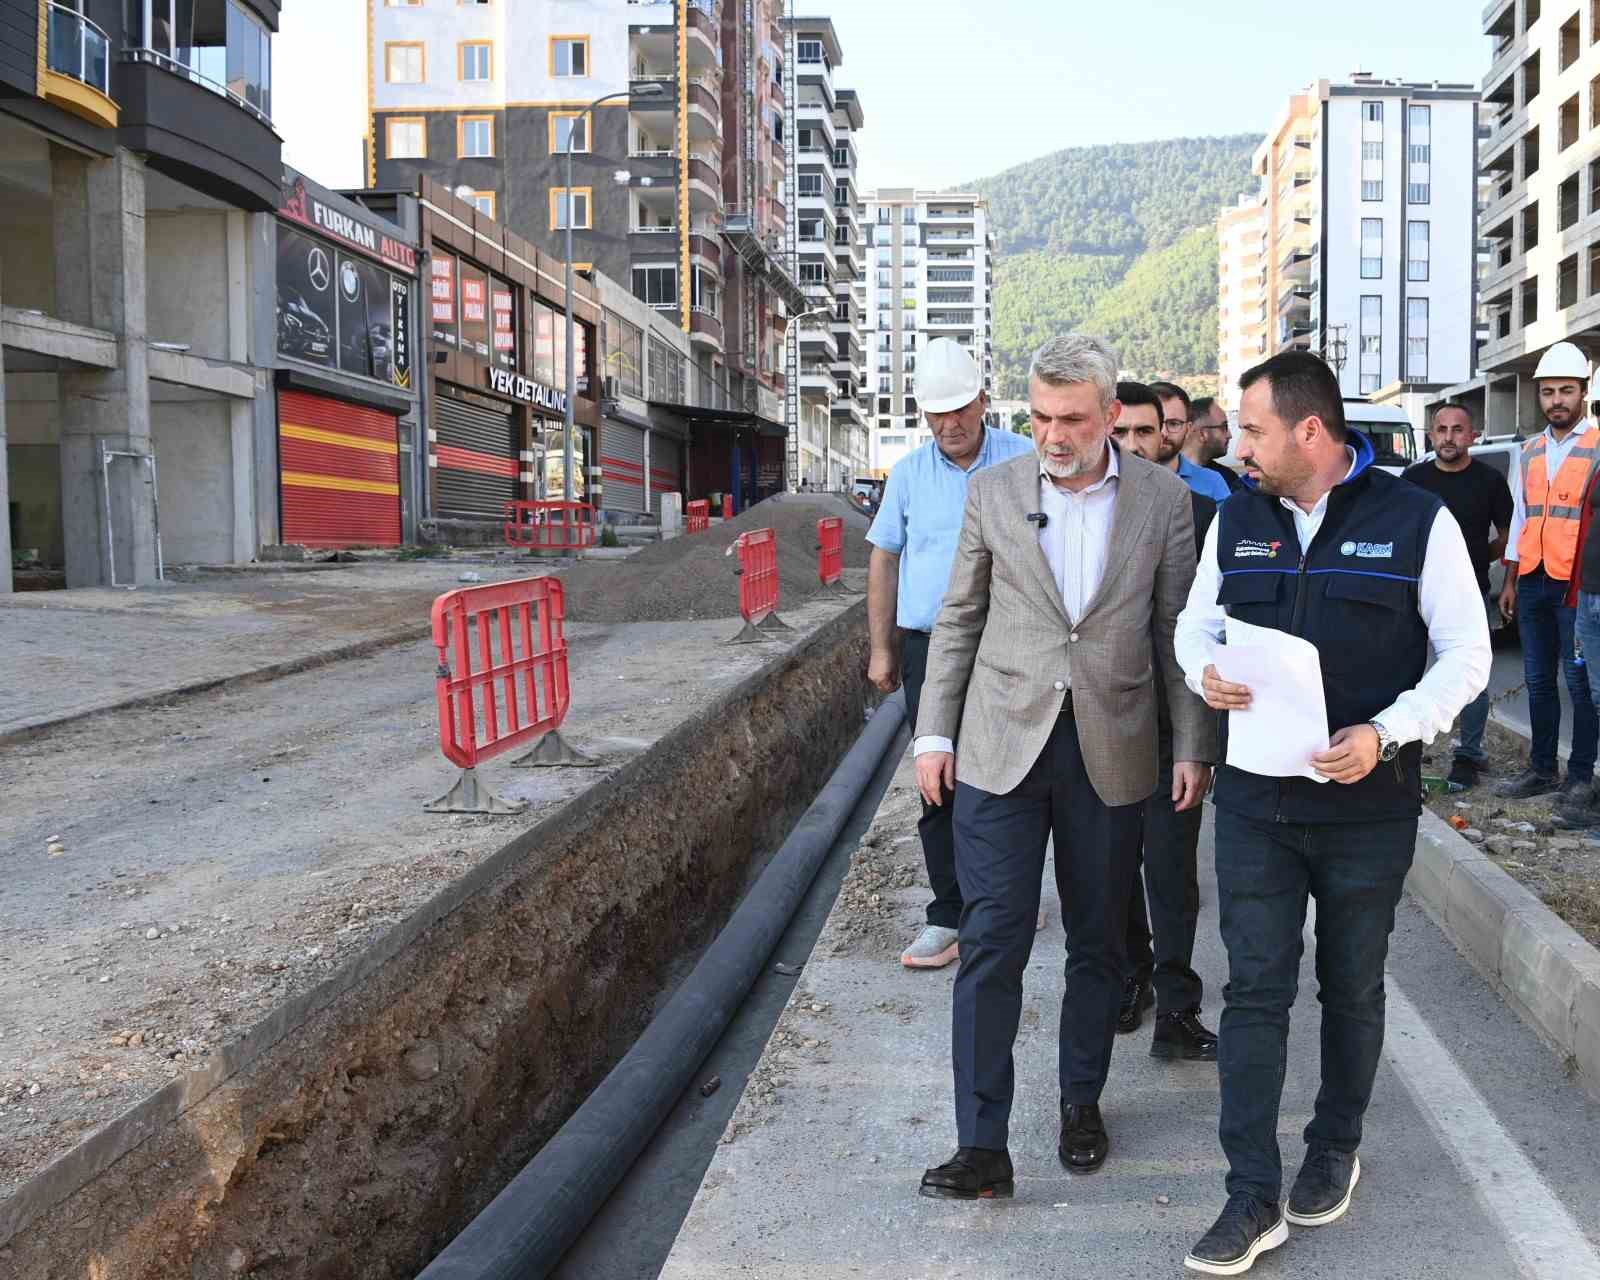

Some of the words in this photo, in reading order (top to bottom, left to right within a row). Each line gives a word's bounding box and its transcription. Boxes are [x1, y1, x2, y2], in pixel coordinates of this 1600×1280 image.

[313, 200, 376, 250] FURKAN
[381, 235, 416, 267] AUTO
[392, 281, 407, 295] OTO
[489, 365, 514, 395] YEK
